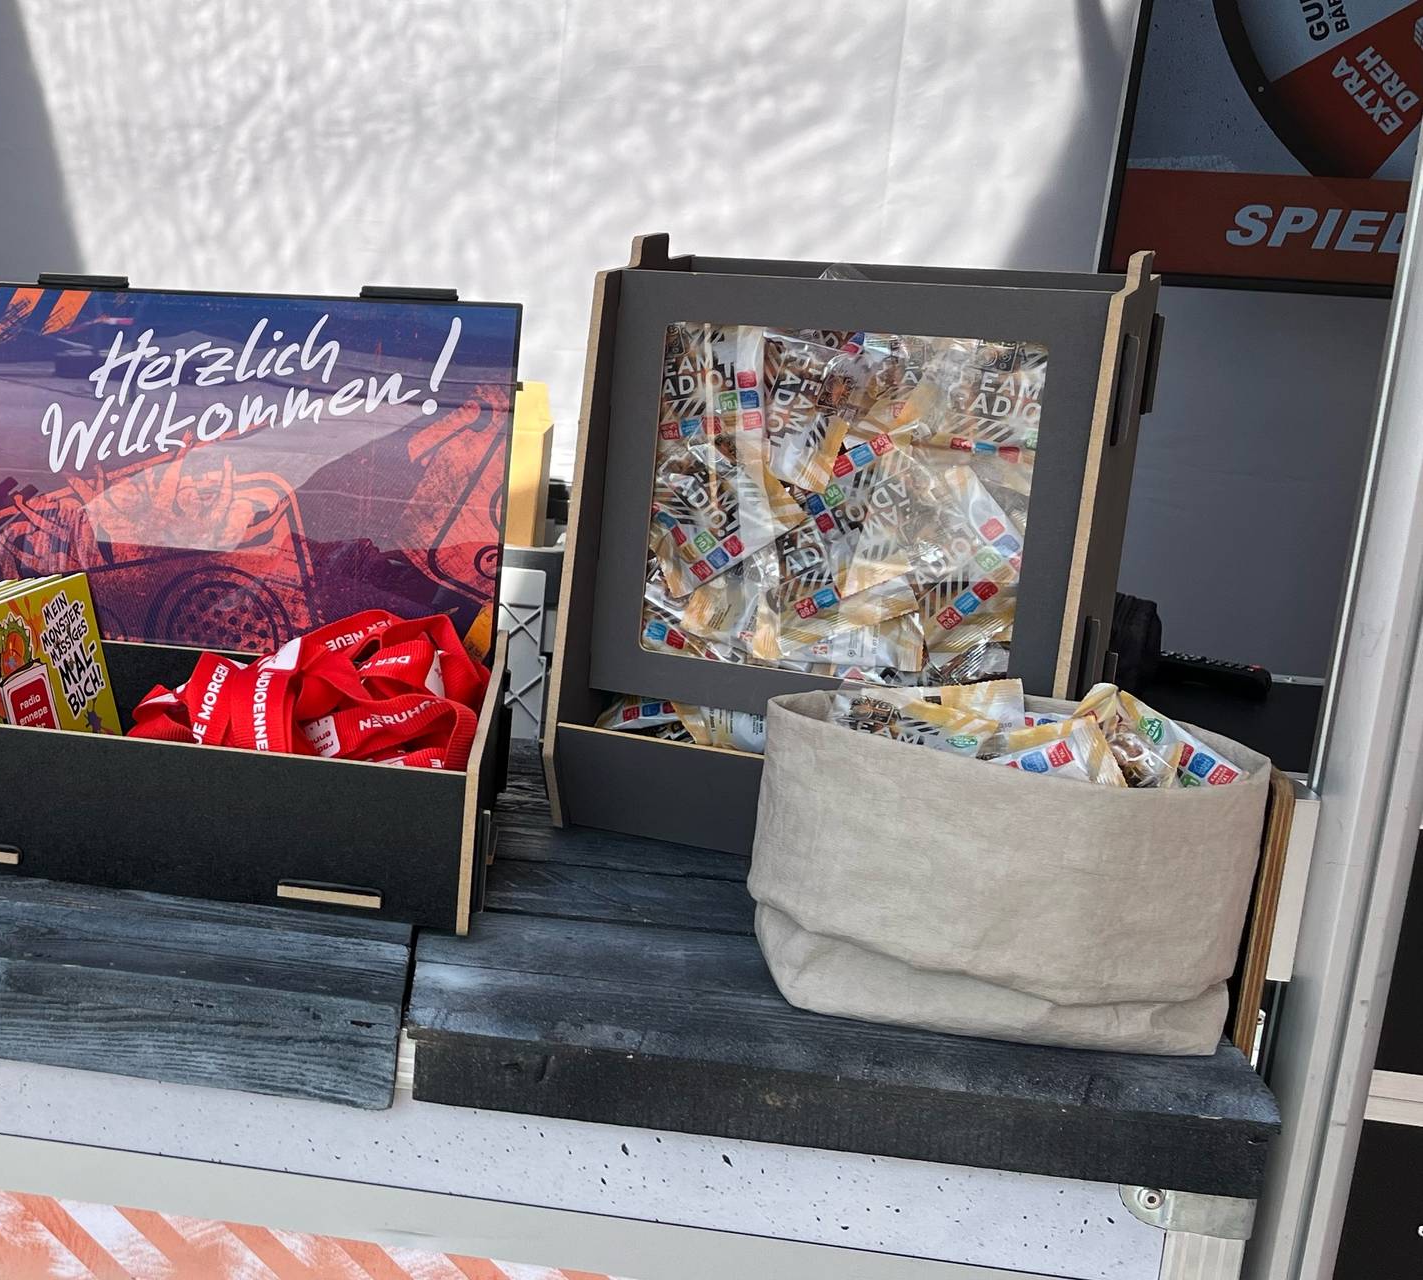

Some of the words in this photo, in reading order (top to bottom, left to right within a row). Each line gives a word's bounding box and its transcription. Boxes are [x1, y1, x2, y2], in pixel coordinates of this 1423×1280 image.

[1300, 0, 1330, 41] GU
[1331, 56, 1404, 136] EXTRA
[1356, 46, 1419, 112] DREH
[1225, 204, 1408, 254] SPIEL
[89, 314, 341, 406] Herzlich
[41, 316, 462, 473] Willkommen!
[41, 602, 84, 650] MONSTER-
[43, 592, 68, 624] MEIN
[325, 629, 365, 652] NEUE
[375, 655, 411, 667] DER
[59, 643, 96, 694] MAL-
[68, 665, 105, 717] BUCH!
[19, 693, 41, 711] radio
[19, 705, 49, 726] ennepe
